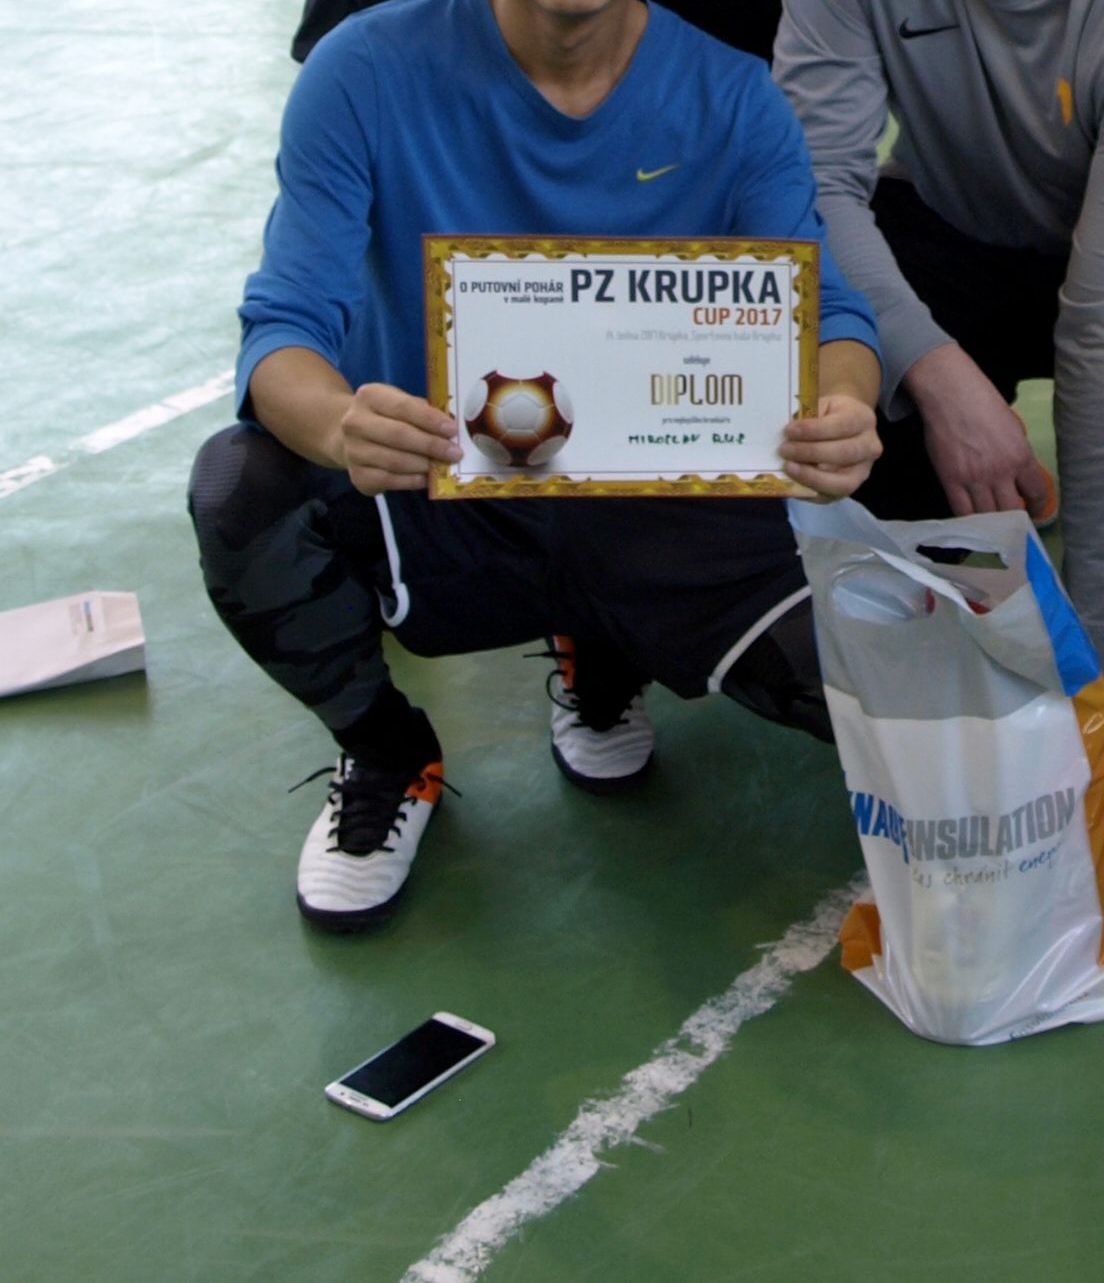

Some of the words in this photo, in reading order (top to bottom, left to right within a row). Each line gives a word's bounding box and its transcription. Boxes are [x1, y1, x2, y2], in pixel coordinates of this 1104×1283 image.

[524, 278, 564, 293] POHÁR
[570, 269, 616, 303] PZ
[629, 270, 782, 304] KRUPKA
[692, 307, 731, 326] CUP
[735, 307, 782, 326] 2017
[650, 373, 743, 405] DIPLOM
